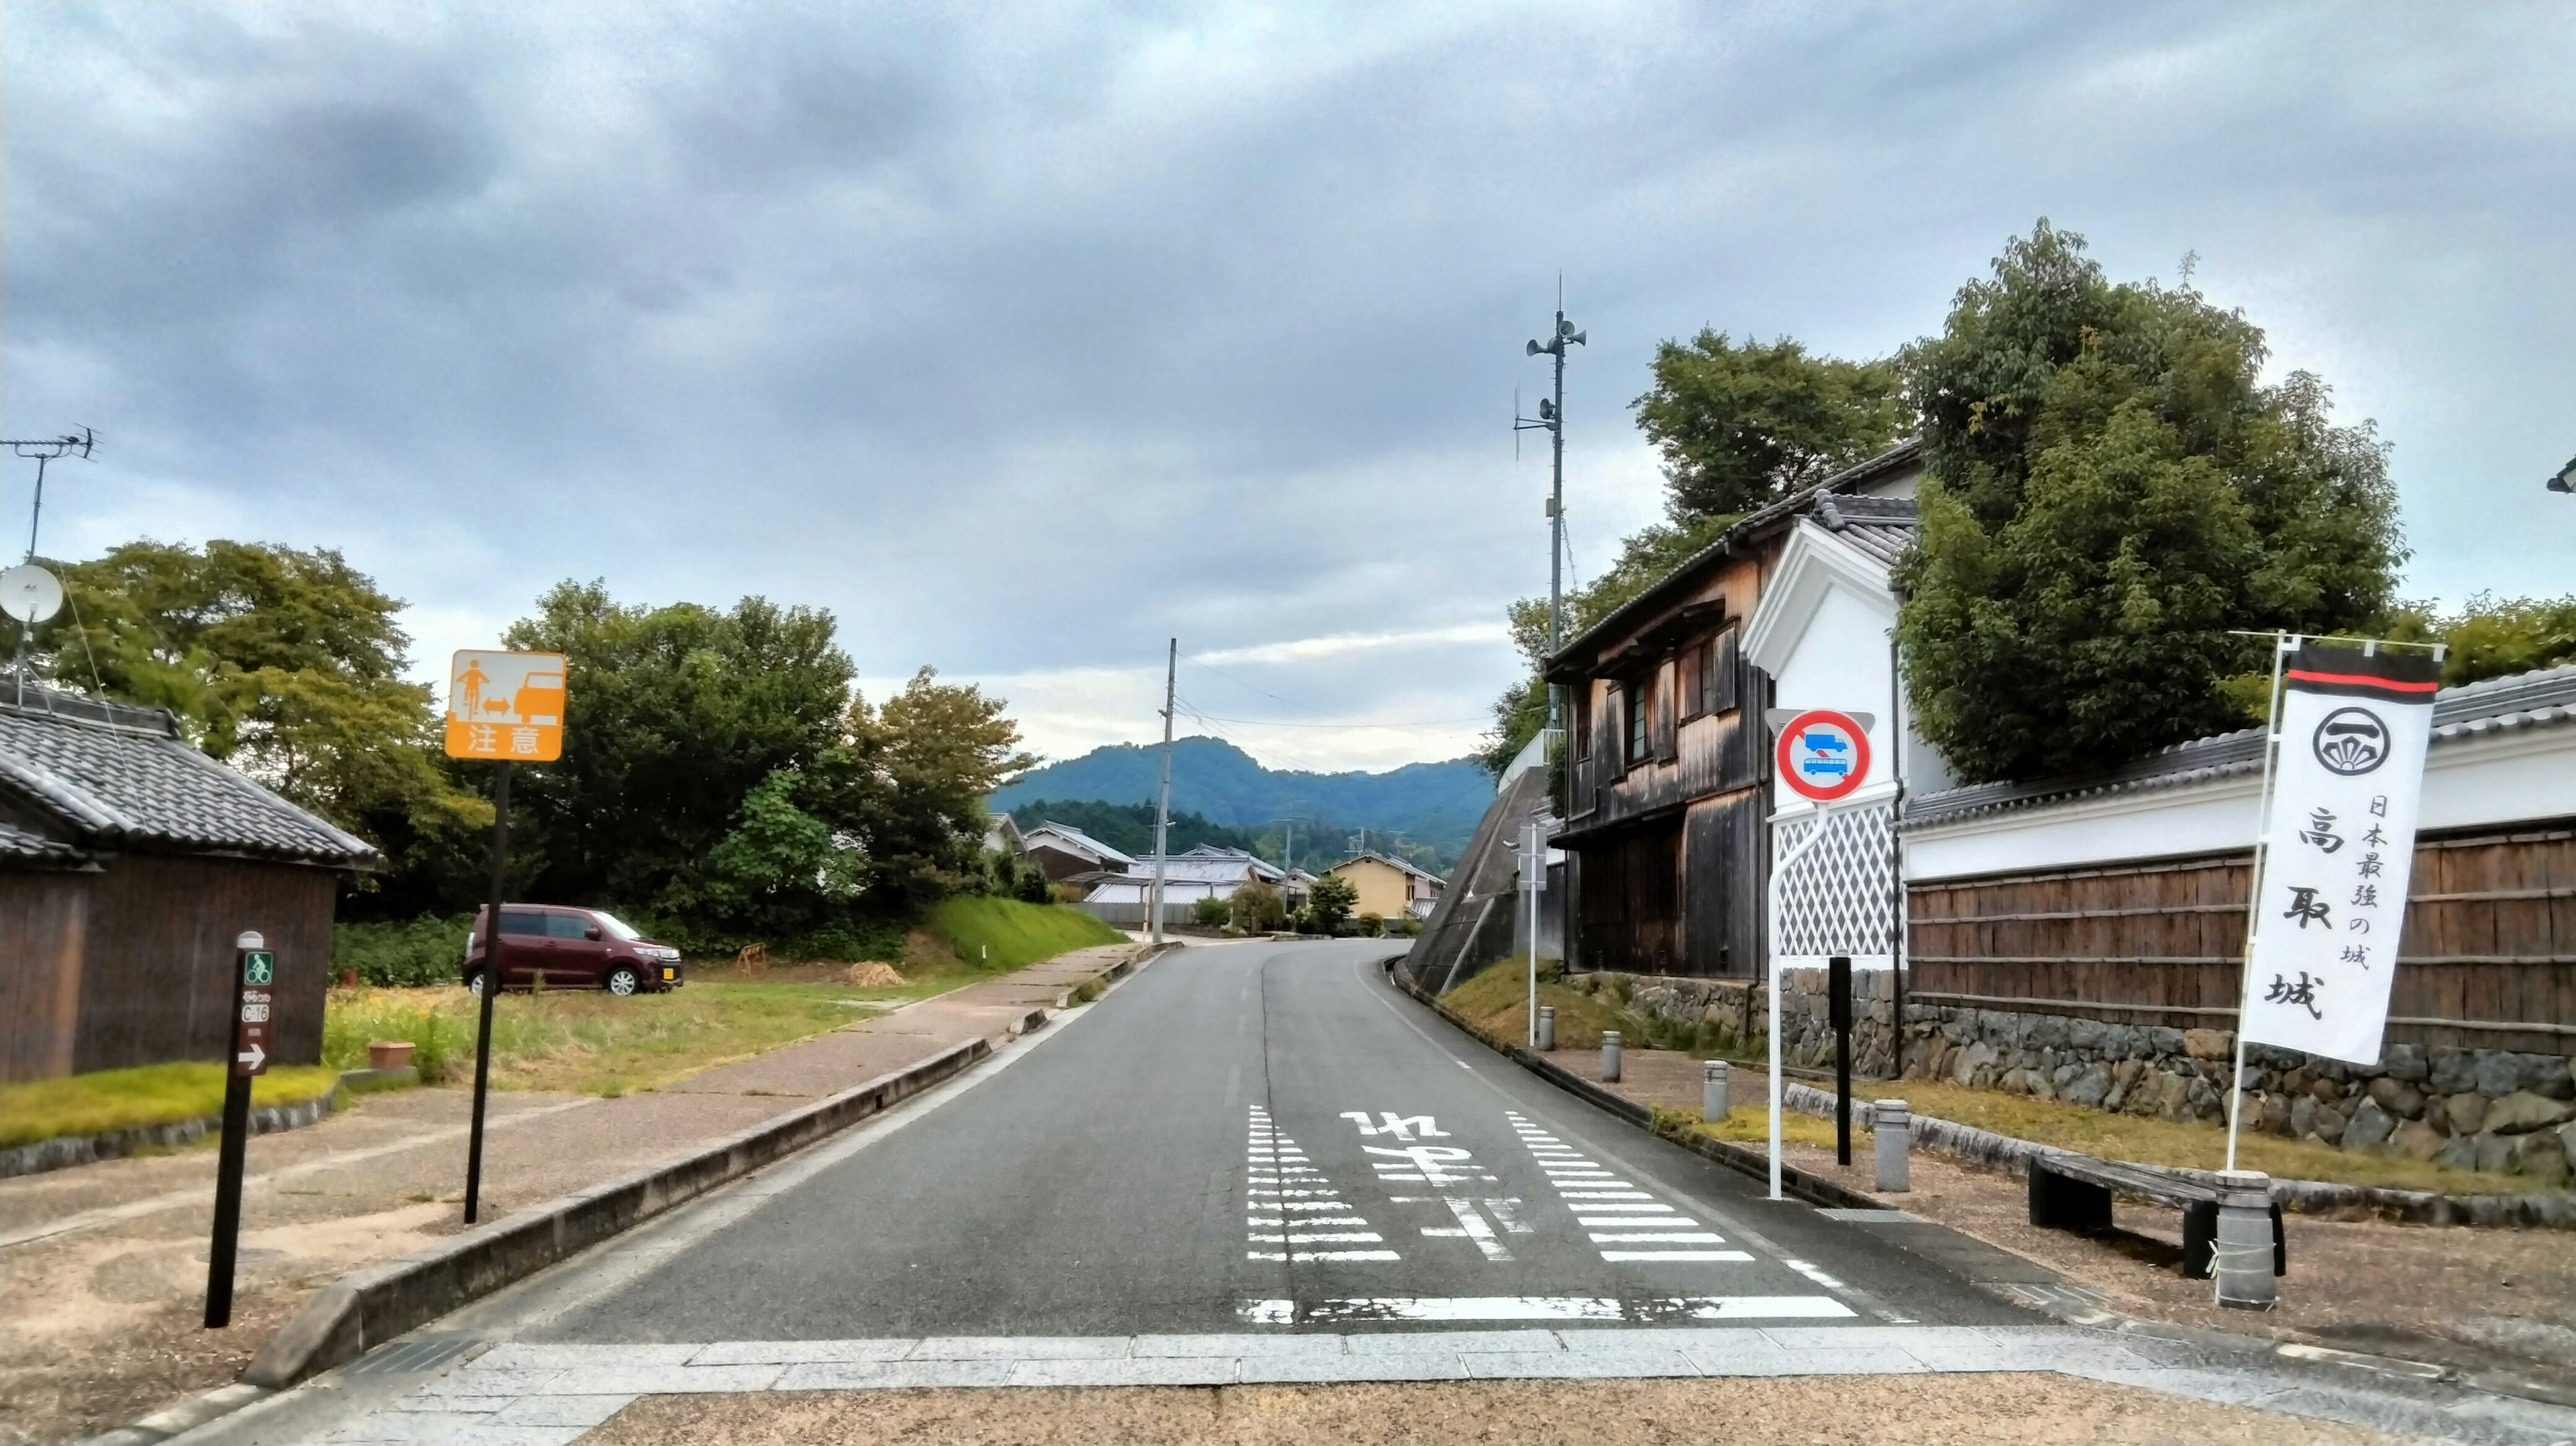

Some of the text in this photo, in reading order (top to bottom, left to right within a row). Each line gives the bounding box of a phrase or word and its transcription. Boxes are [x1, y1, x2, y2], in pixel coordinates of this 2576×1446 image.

[468, 724, 539, 754] 注意
[2263, 805, 2345, 1021] 高取城
[2339, 794, 2388, 970] 日本最強の城
[244, 1006, 268, 1021] C-16
